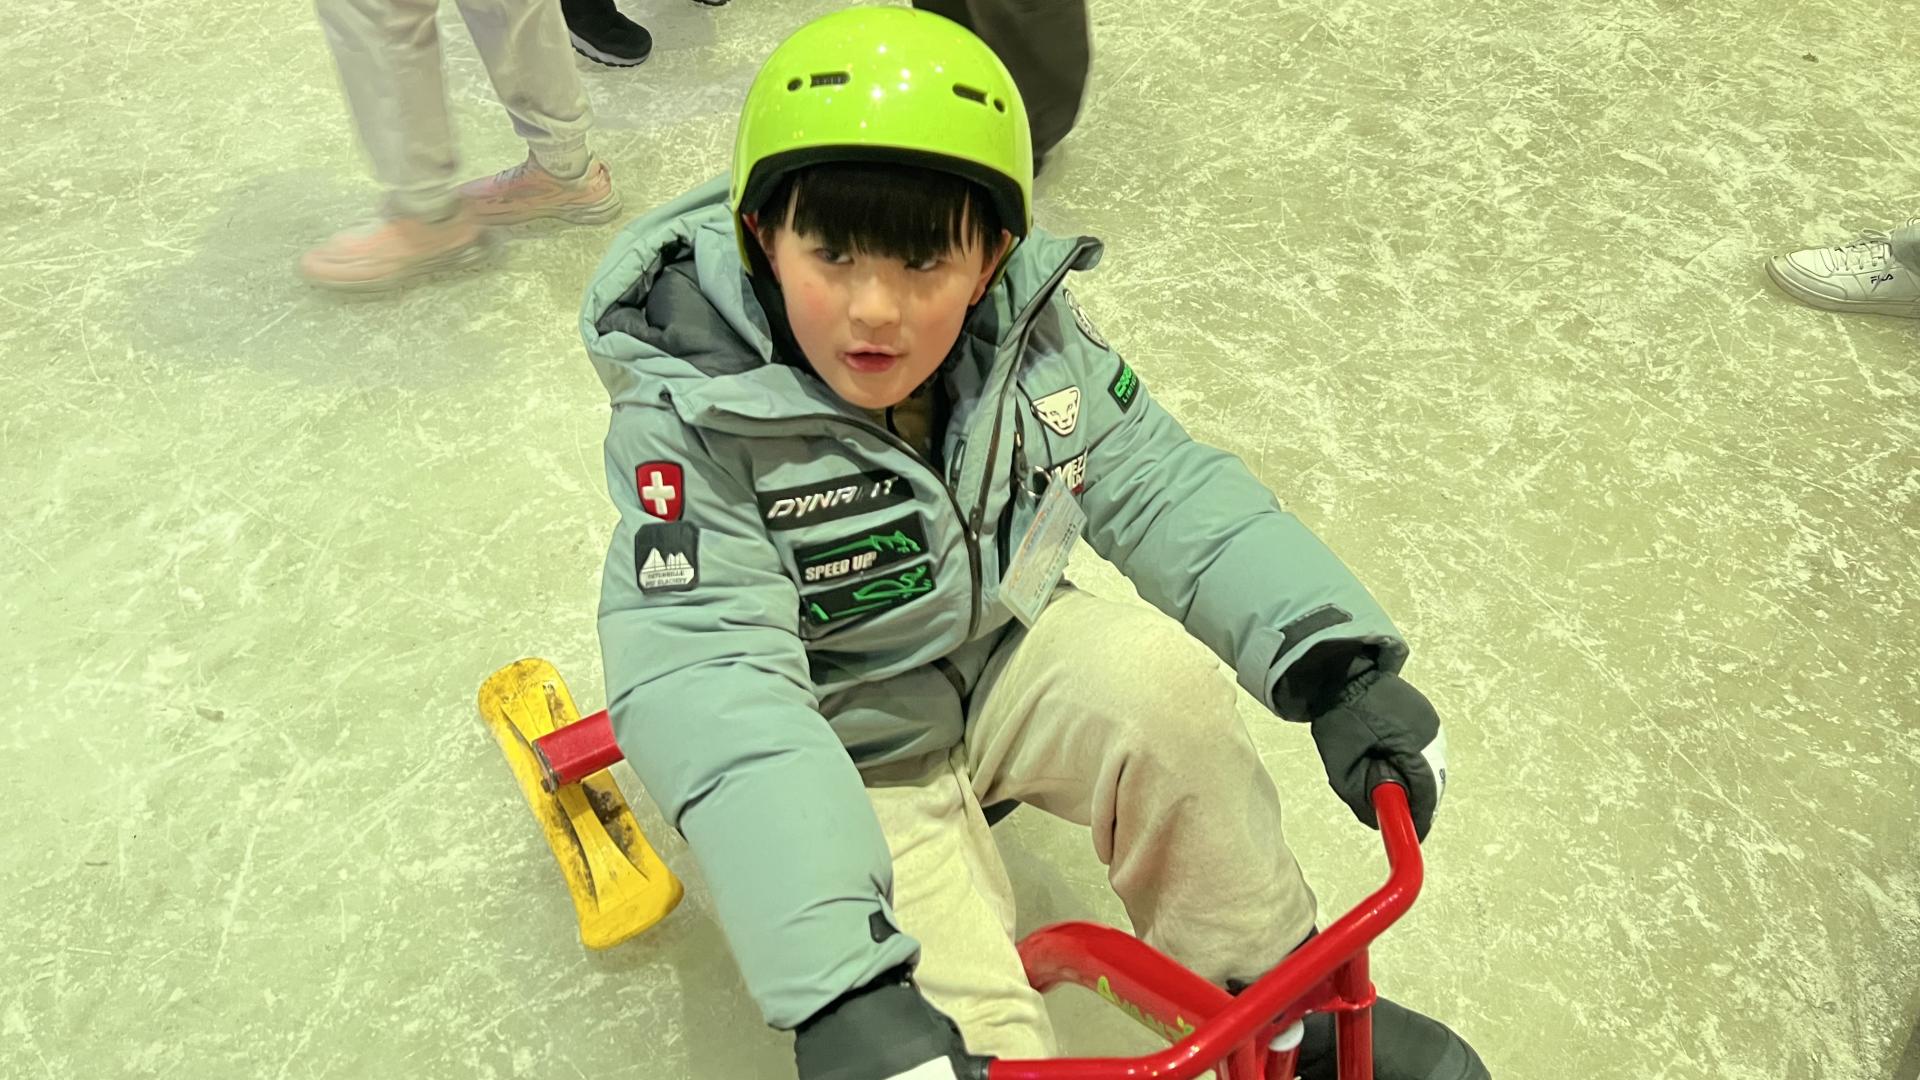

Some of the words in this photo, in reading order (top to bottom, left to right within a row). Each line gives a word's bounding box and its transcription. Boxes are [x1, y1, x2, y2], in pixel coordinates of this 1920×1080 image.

[767, 475, 899, 518] DYNAIT
[805, 559, 850, 581] SPEED
[852, 551, 877, 570] UP
